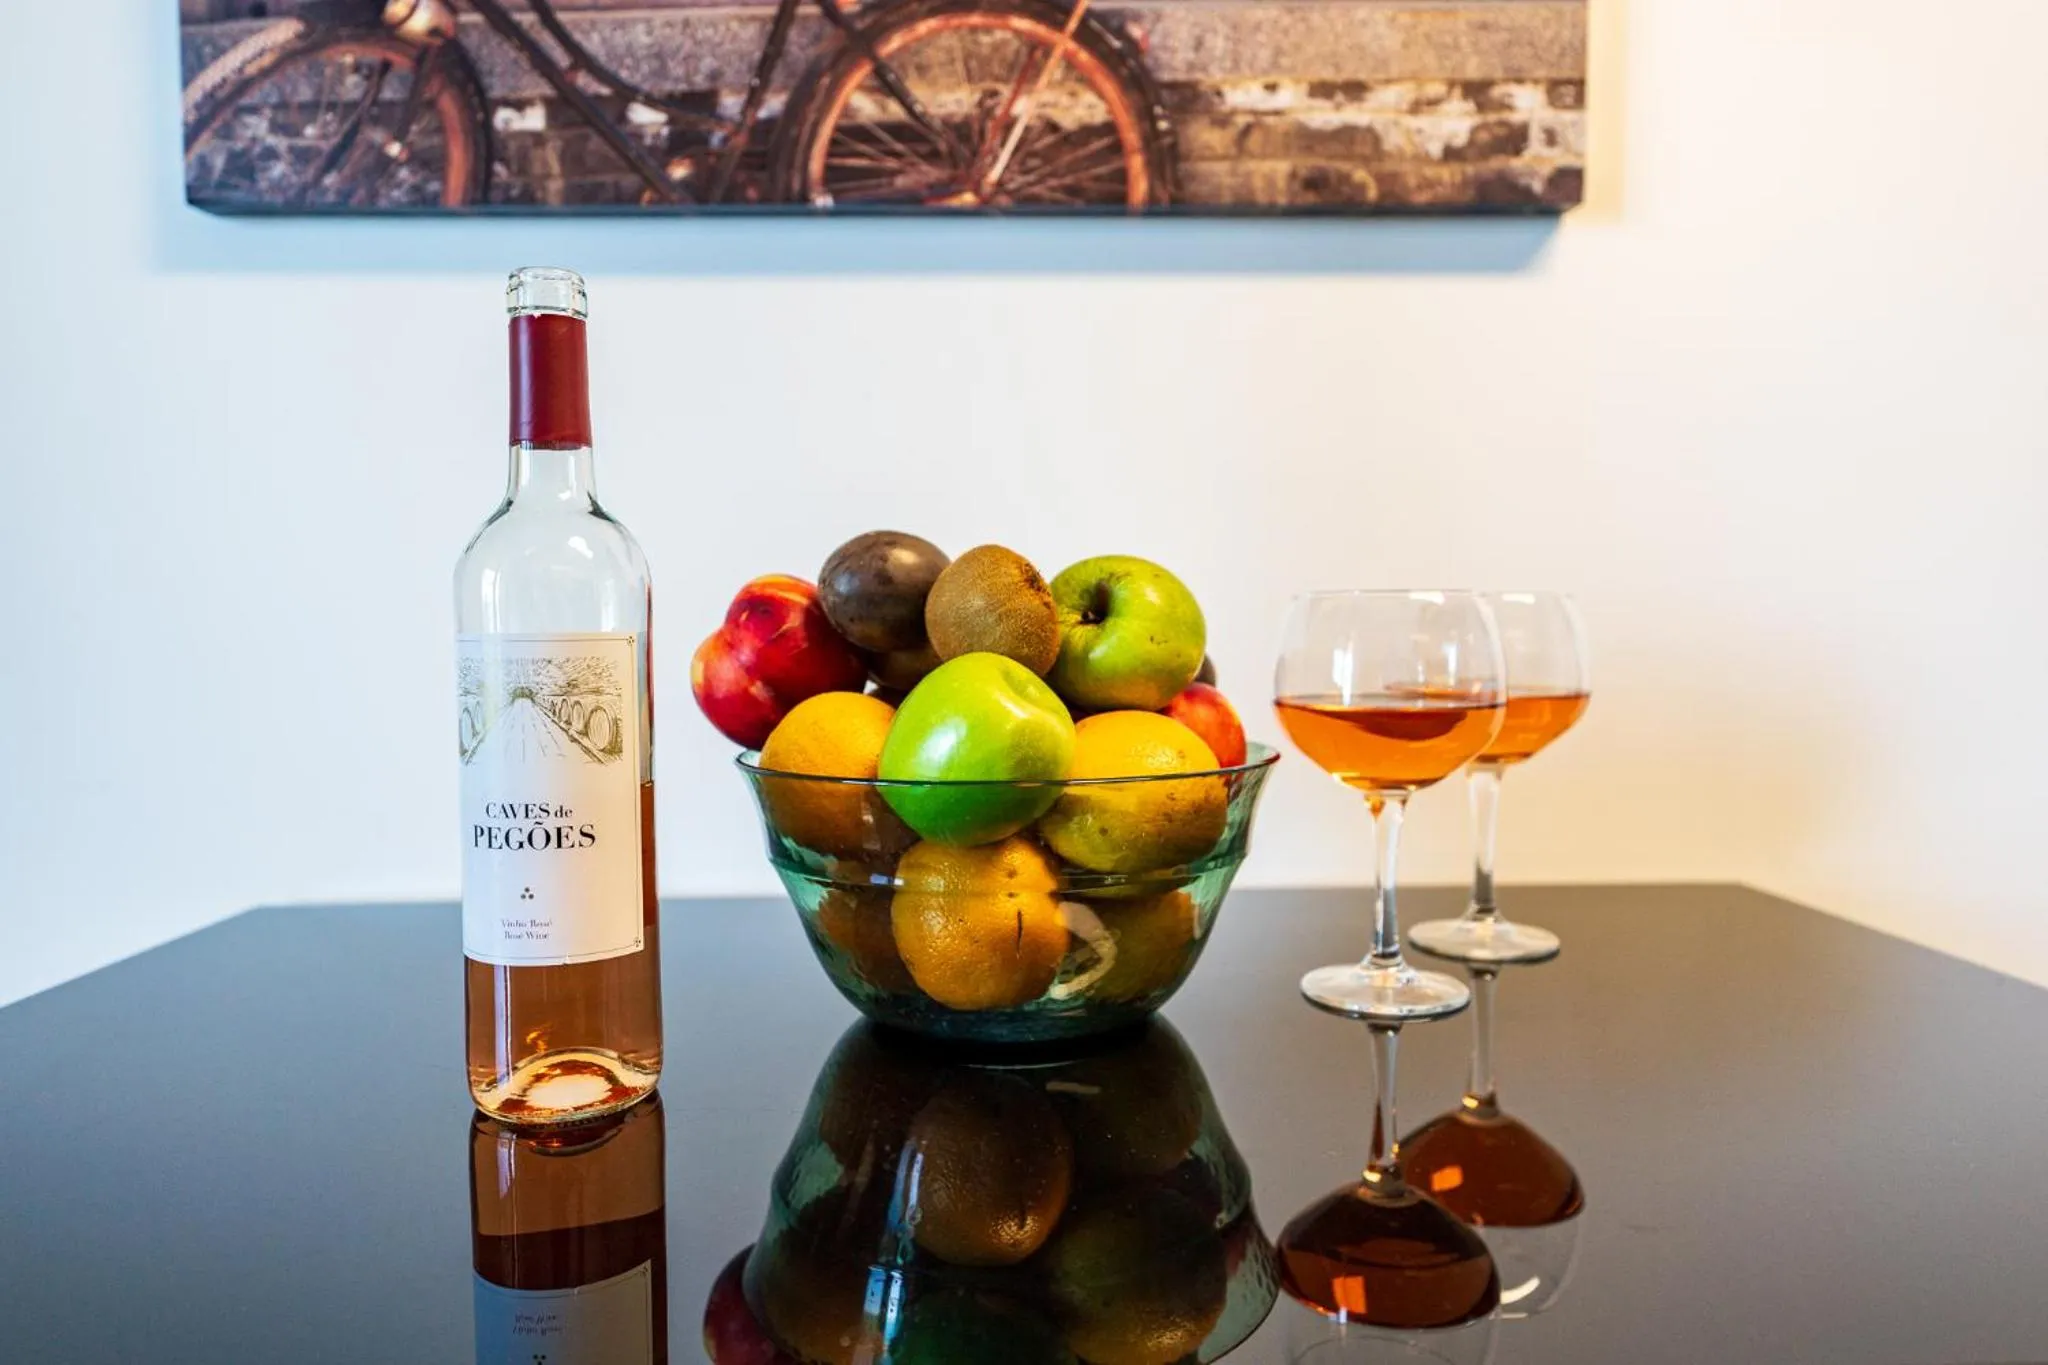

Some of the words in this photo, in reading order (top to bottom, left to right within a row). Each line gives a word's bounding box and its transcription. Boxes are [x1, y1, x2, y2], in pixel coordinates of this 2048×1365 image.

[485, 802, 550, 819] CAVES
[554, 805, 573, 818] de
[474, 821, 596, 850] PEGÕES
